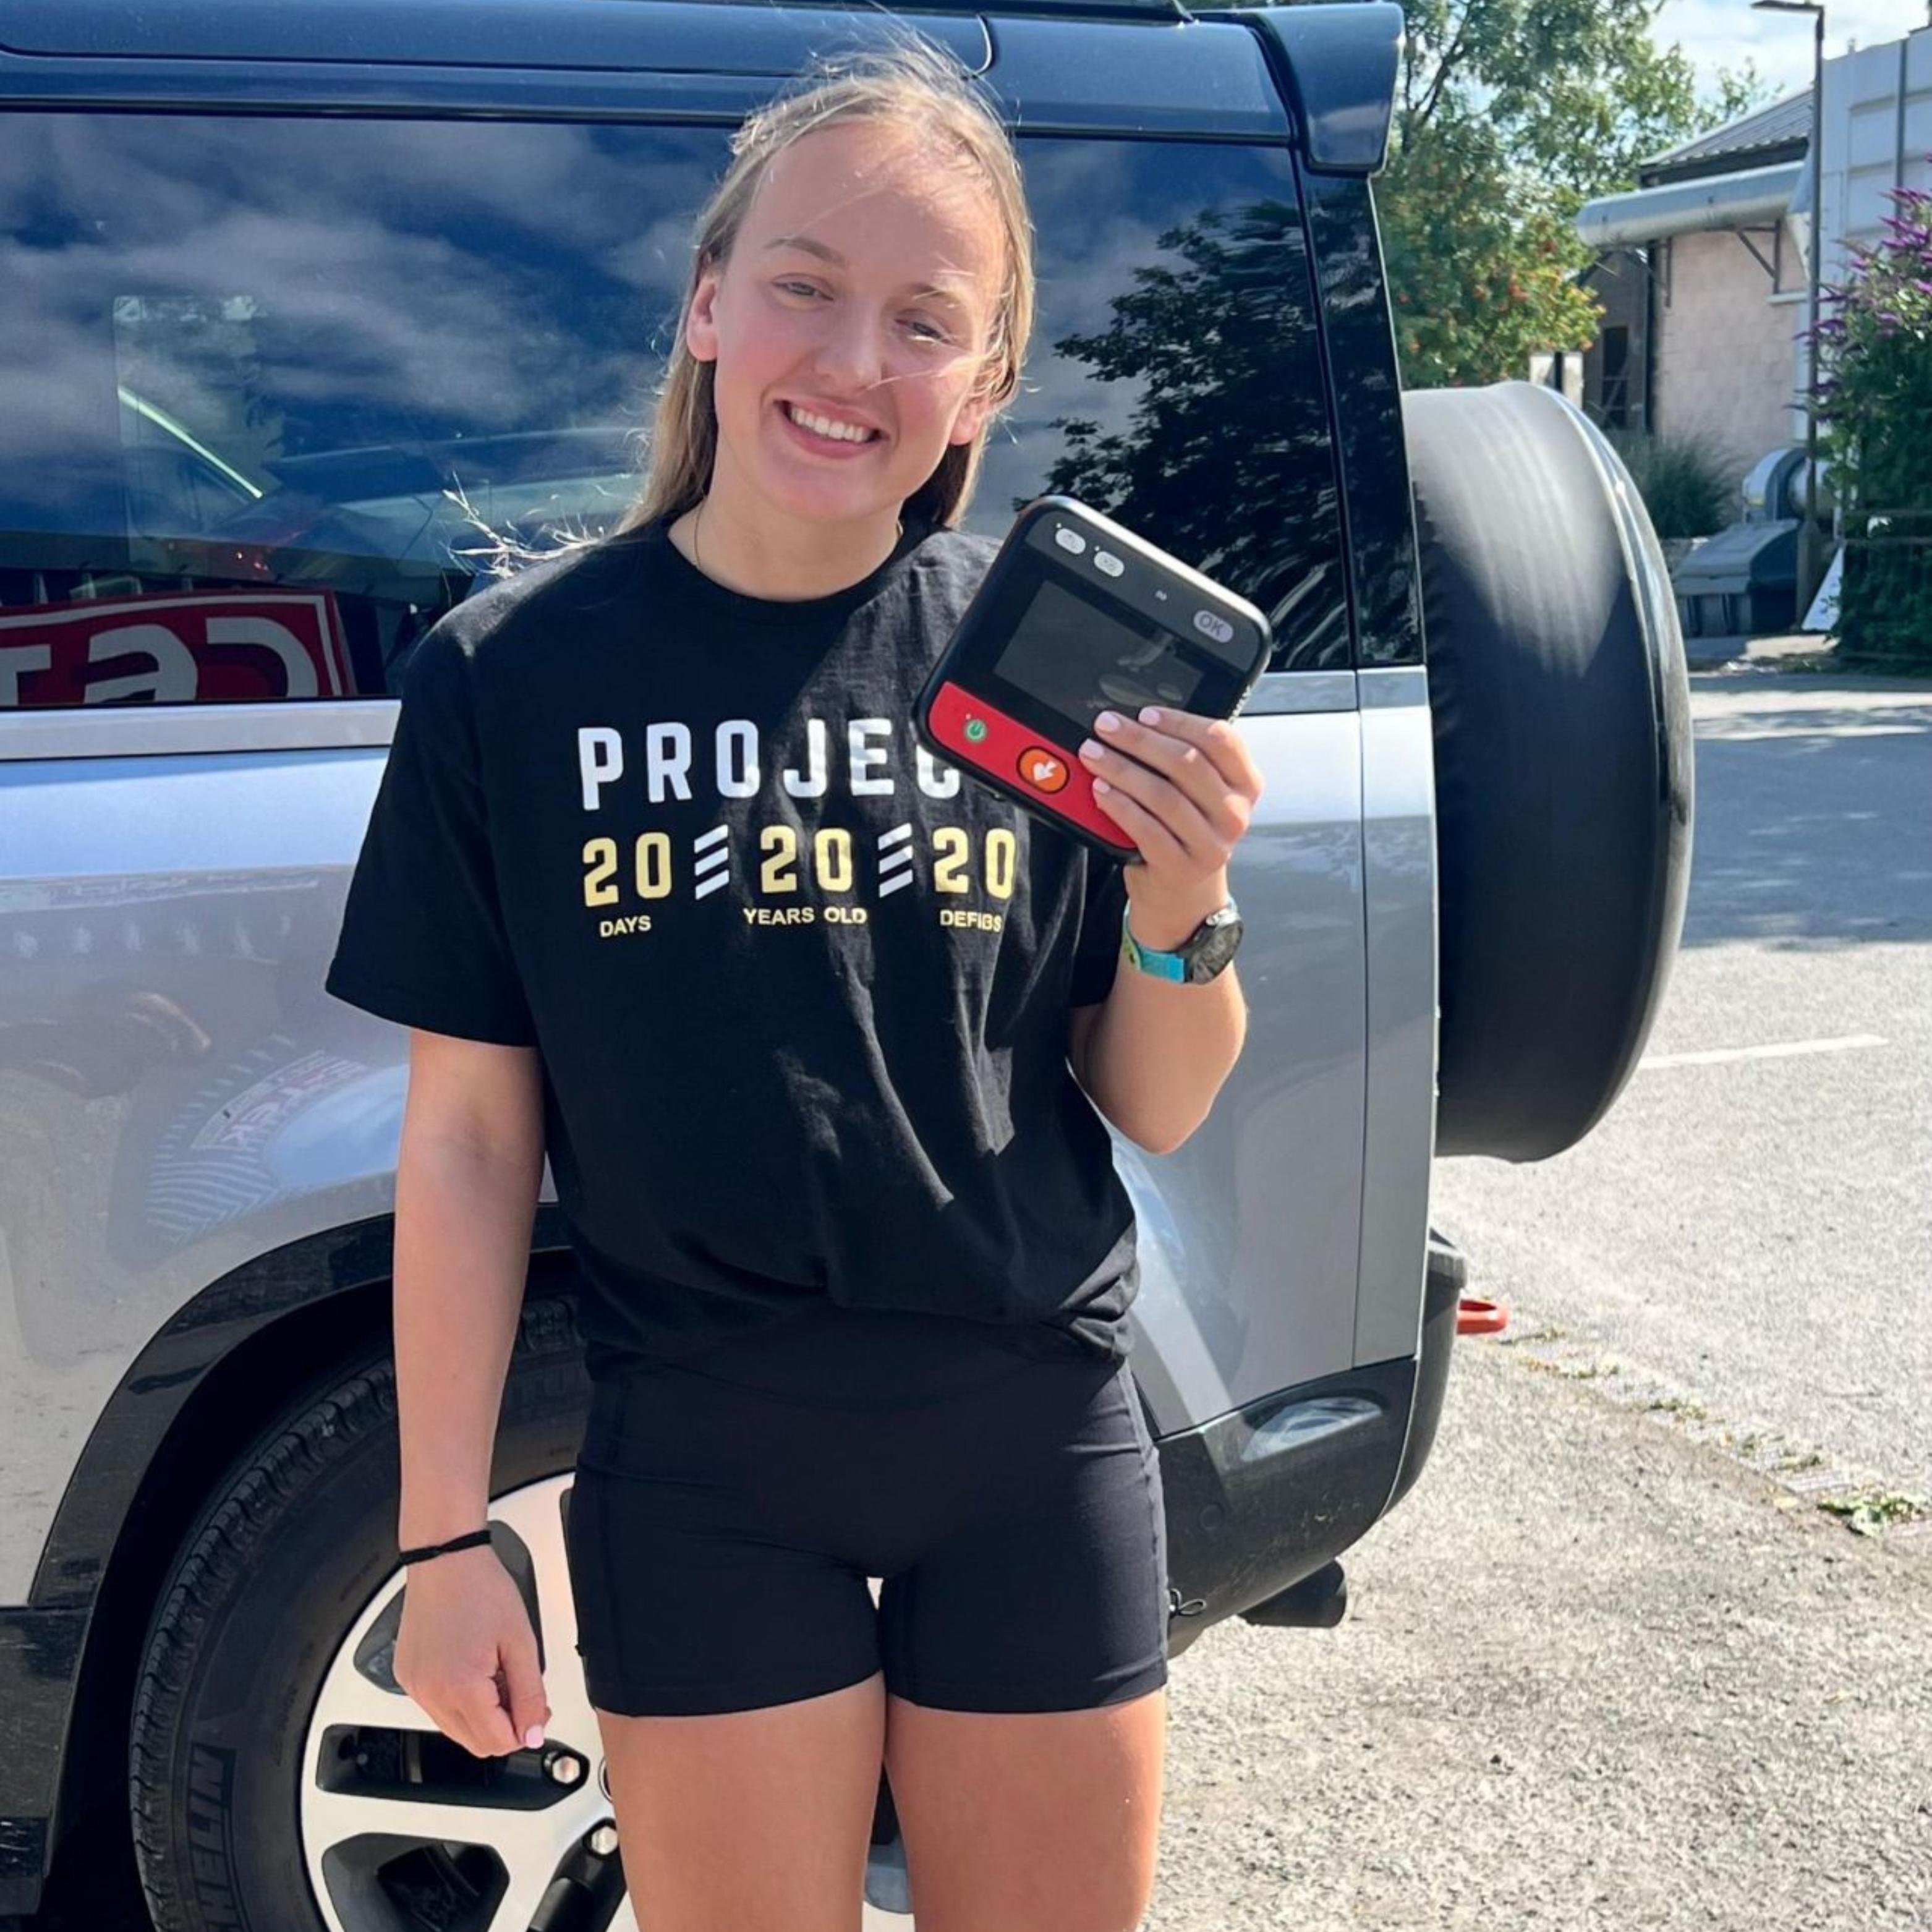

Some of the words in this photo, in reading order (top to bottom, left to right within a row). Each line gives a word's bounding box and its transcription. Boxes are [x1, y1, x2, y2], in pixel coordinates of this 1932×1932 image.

[1199, 613, 1224, 636] OK
[577, 718, 960, 810] PROJEC
[582, 832, 673, 907] 20
[760, 825, 853, 893] 20
[932, 827, 1016, 900] 20
[600, 915, 652, 938] DAYS
[743, 907, 815, 926] YEARS
[823, 906, 867, 924] OLD
